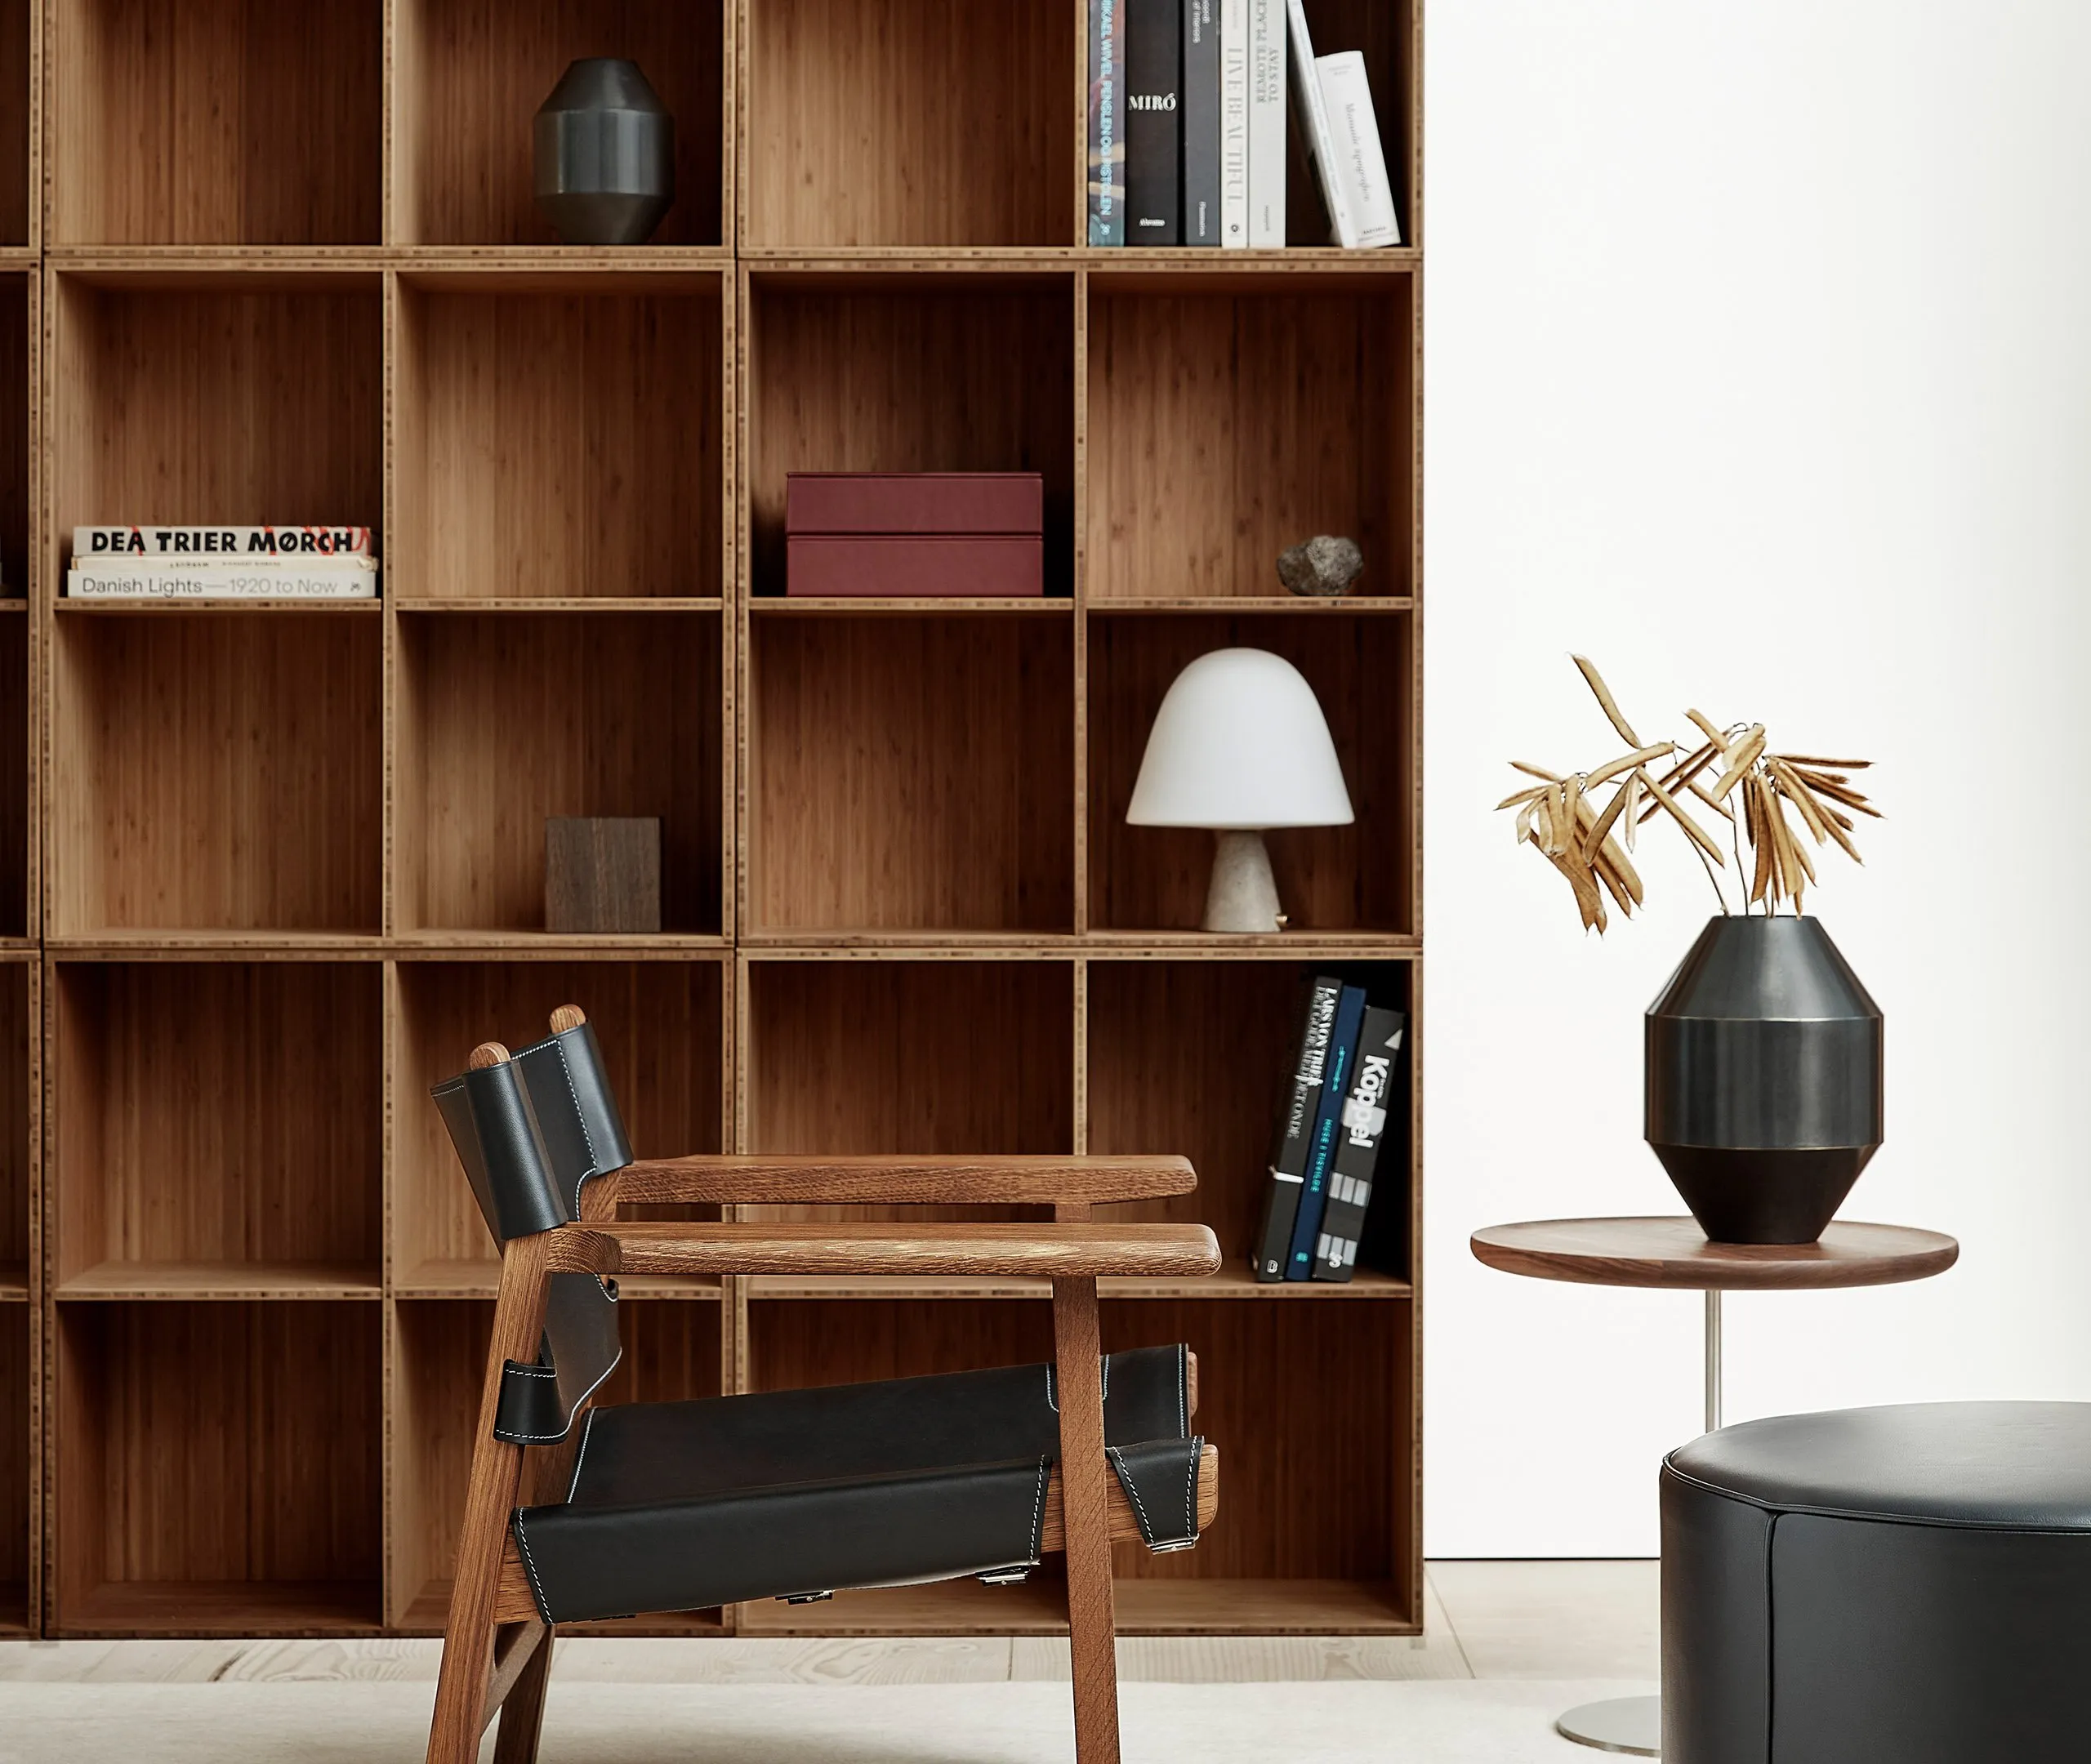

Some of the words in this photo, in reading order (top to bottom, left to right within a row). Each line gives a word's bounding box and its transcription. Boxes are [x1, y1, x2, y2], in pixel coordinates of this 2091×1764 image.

[1101, 39, 1112, 78] WIVEL
[1228, 48, 1242, 92] LIVE
[1256, 45, 1267, 103] REMOTE
[1268, 47, 1278, 82] STAY
[1101, 80, 1112, 135] PENSLEN
[1129, 93, 1176, 111] MIRÓ
[1268, 84, 1278, 102] TO
[1227, 96, 1242, 206] BEAUTIFUL
[1101, 158, 1112, 216] PISTOLEN
[91, 532, 145, 551] DEA
[156, 532, 237, 551] TRIER
[247, 531, 352, 552] MØRCH
[82, 577, 142, 594] Danish
[149, 577, 203, 598] Lights
[230, 578, 271, 594] 1920
[275, 579, 292, 594] to
[298, 579, 338, 594] Now
[1349, 1054, 1389, 1148] Koppel
